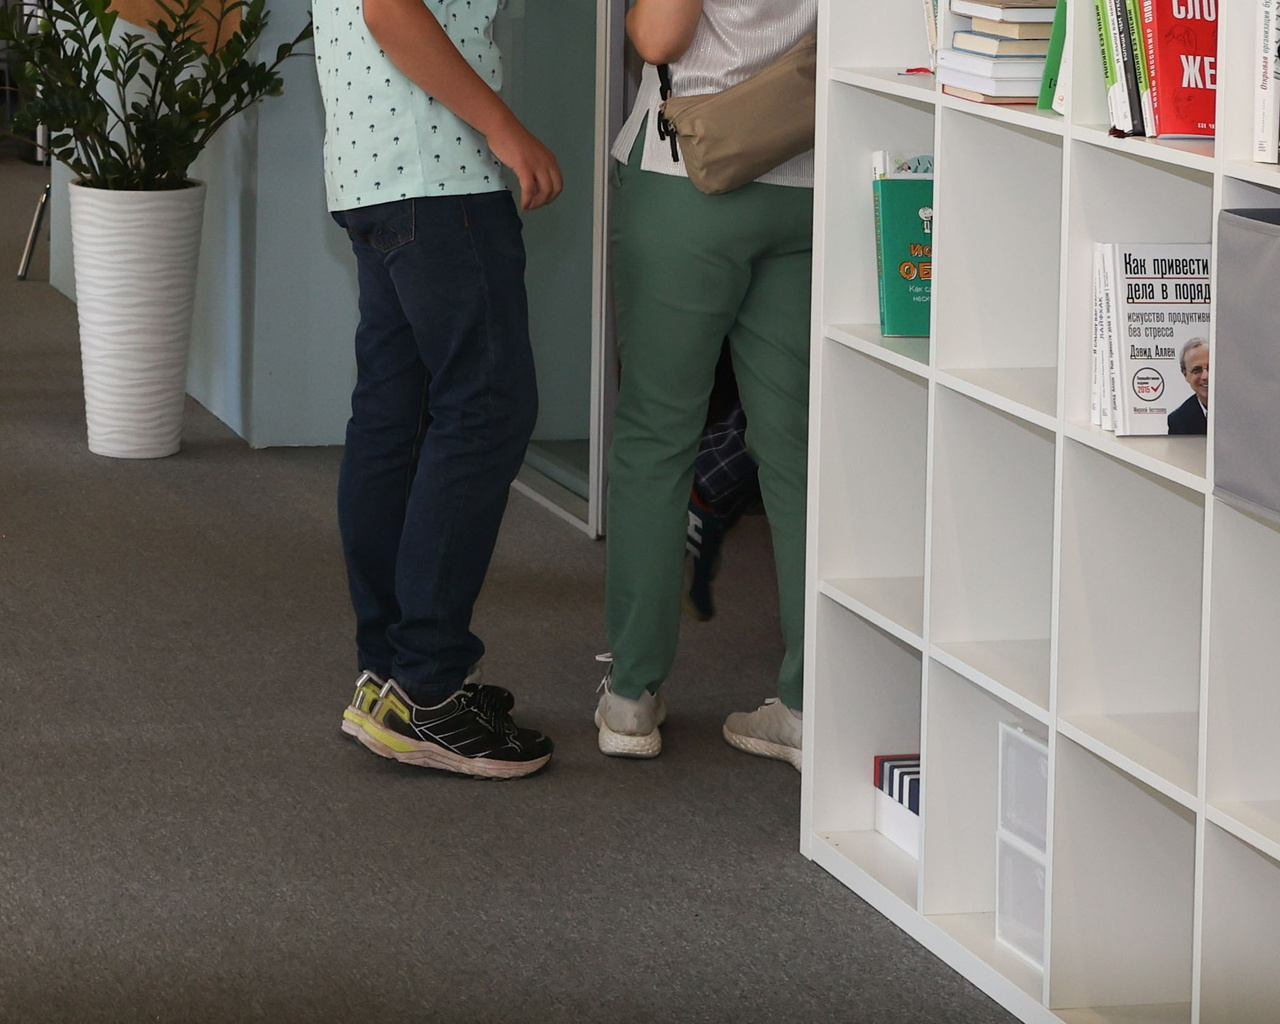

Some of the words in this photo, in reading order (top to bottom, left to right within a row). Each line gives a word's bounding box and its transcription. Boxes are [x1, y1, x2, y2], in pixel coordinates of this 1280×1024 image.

[1262, 9, 1271, 54] организации
[1260, 56, 1269, 91] Открывая
[1124, 252, 1147, 275] Как
[1153, 258, 1210, 279] привести
[1126, 283, 1155, 304] дела
[1161, 283, 1169, 300] в
[1127, 312, 1165, 325] искусство
[1128, 324, 1142, 337] без
[1144, 326, 1174, 340] стресса
[1130, 344, 1152, 360] Дэвид
[1155, 344, 1176, 358] Аллен
[1137, 386, 1151, 394] 2015
